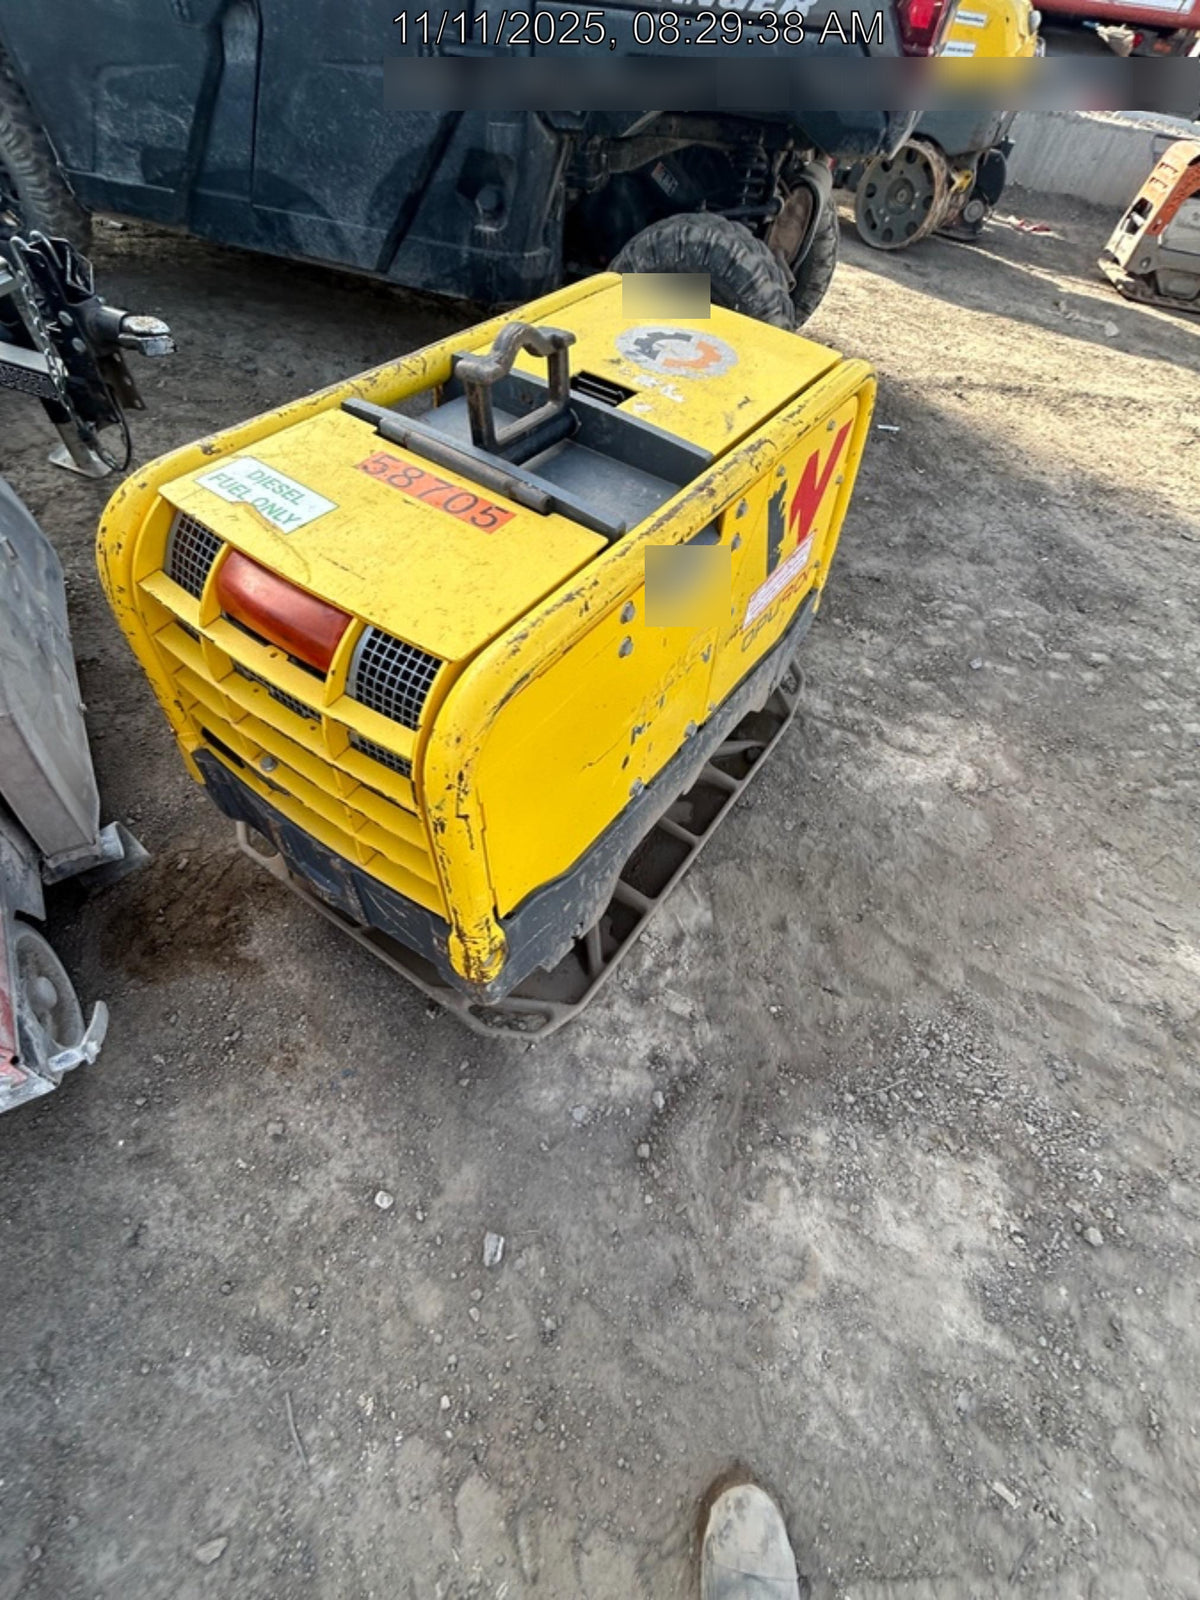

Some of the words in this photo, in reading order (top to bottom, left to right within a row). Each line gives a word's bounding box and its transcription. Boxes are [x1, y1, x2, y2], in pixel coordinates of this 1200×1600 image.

[207, 472, 254, 501] FUEL
[252, 497, 302, 526] ONLY
[245, 468, 309, 506] DIESEL
[361, 451, 508, 529] 58705
